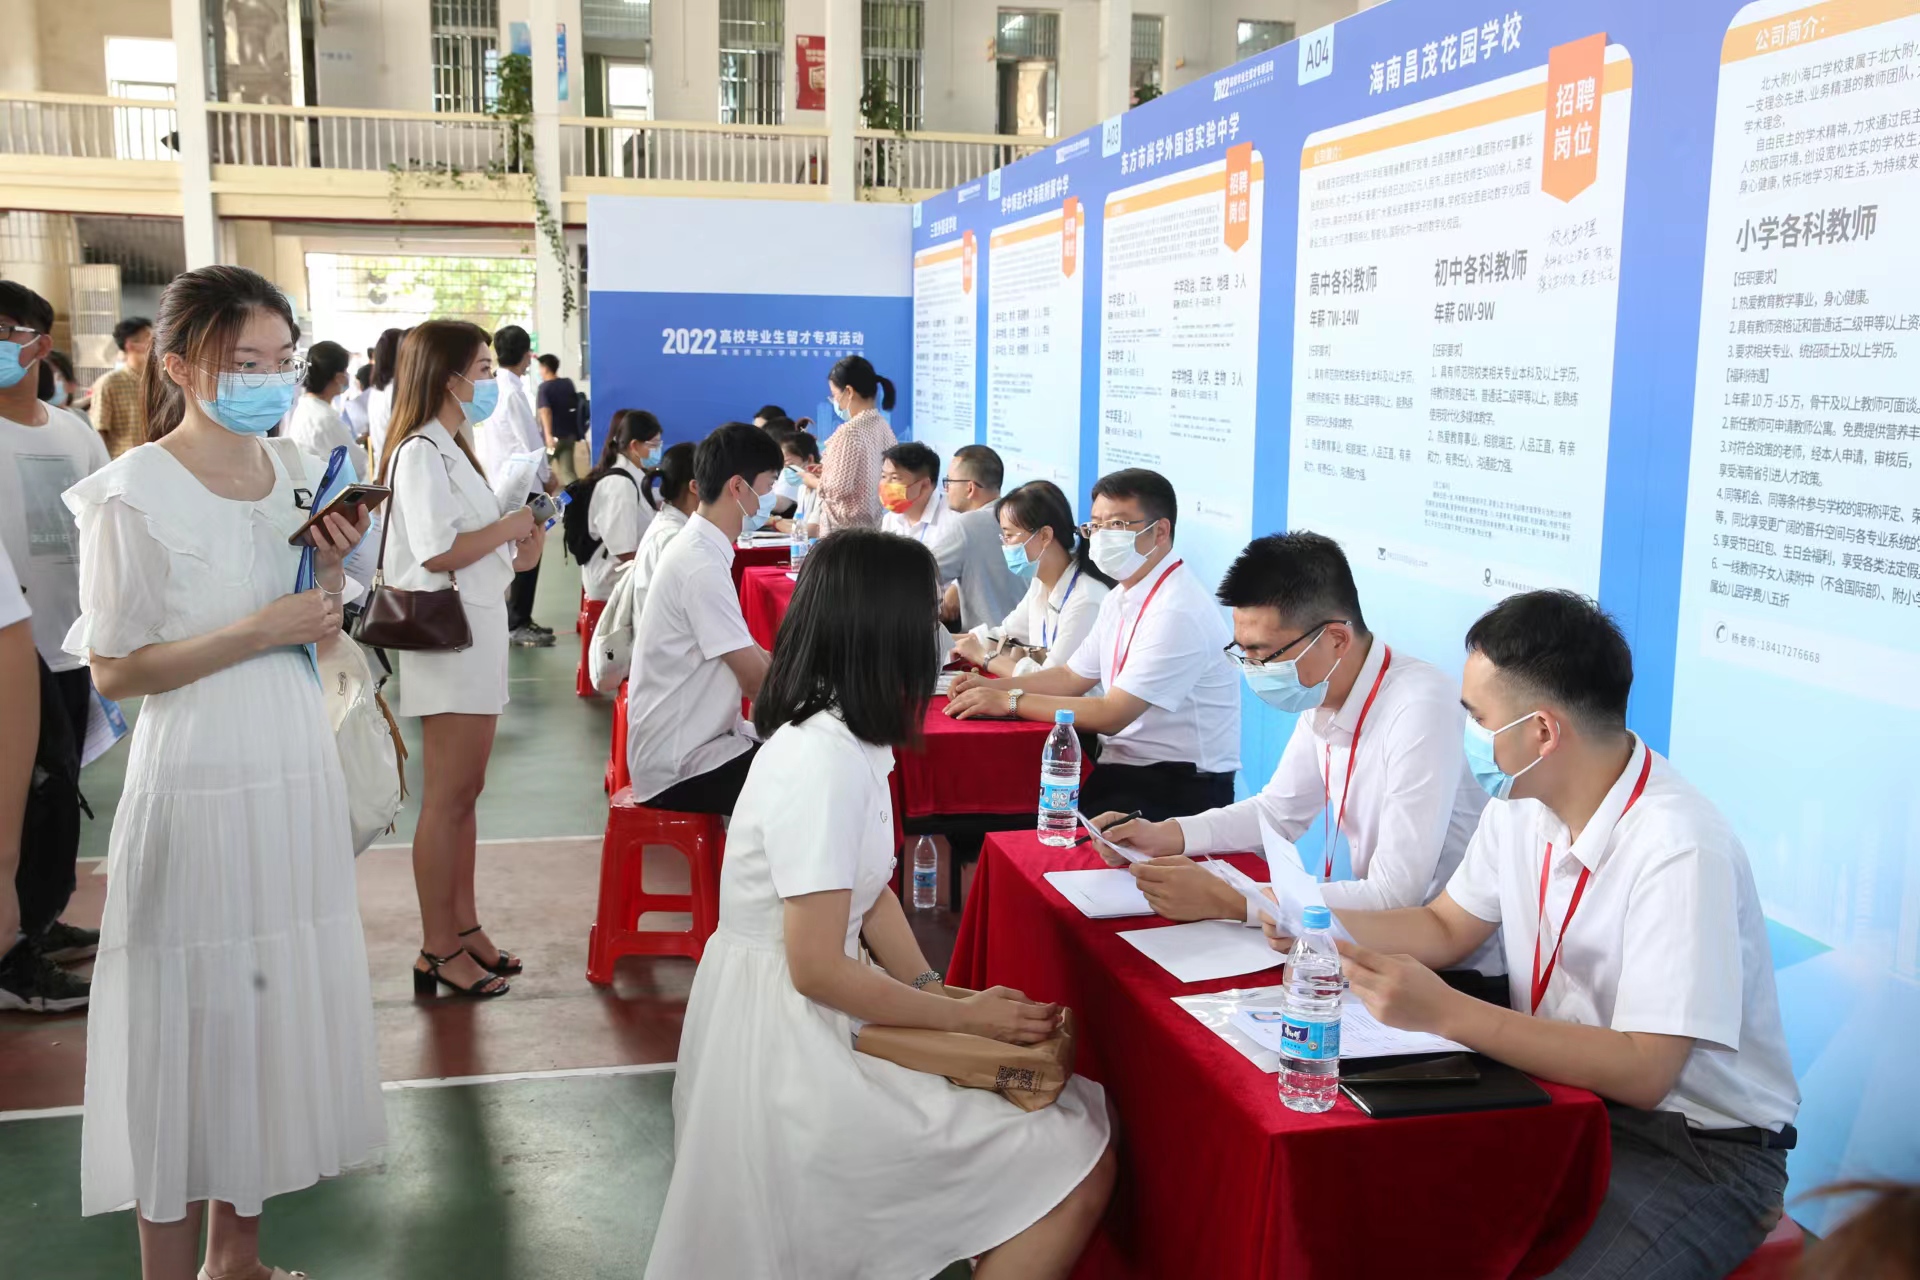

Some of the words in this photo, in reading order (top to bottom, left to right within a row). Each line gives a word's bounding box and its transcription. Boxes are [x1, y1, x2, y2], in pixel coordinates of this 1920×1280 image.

[1755, 15, 1826, 51] 公司简介：
[1305, 35, 1330, 72] A04
[1369, 11, 1523, 96] 海南昌茂花园学校
[1556, 75, 1596, 119] 招聘
[1745, 64, 1920, 113] 一支理念先进、业务精湛的教师团队，
[1105, 124, 1119, 148] A03
[1121, 112, 1240, 176] 东方市尚学外国语实验中学
[1553, 120, 1593, 161] 岗位
[1741, 131, 1920, 175] 人的校园环境，创设宽松充实的学校生
[1228, 170, 1248, 195] 招聘
[1228, 199, 1248, 223] 岗位
[1735, 203, 1879, 253] 小学各科教师
[1309, 265, 1378, 297] 高中各科教师
[1434, 248, 1528, 287] 初中各科教师
[1733, 268, 1777, 287] 【任职要求】
[661, 327, 718, 355] 2022
[719, 328, 865, 346] 高校毕业生留才专项活动
[1728, 313, 1920, 336] 2.具有教师资格证和普通话二级甲等以上资
[1719, 463, 1823, 487] 享受海南省引进人才政策。
[1712, 534, 1920, 580] 5.享受节日红包、生日会福利，享受各类法定假
[1709, 579, 1790, 608] 属幼儿园学费八五折
